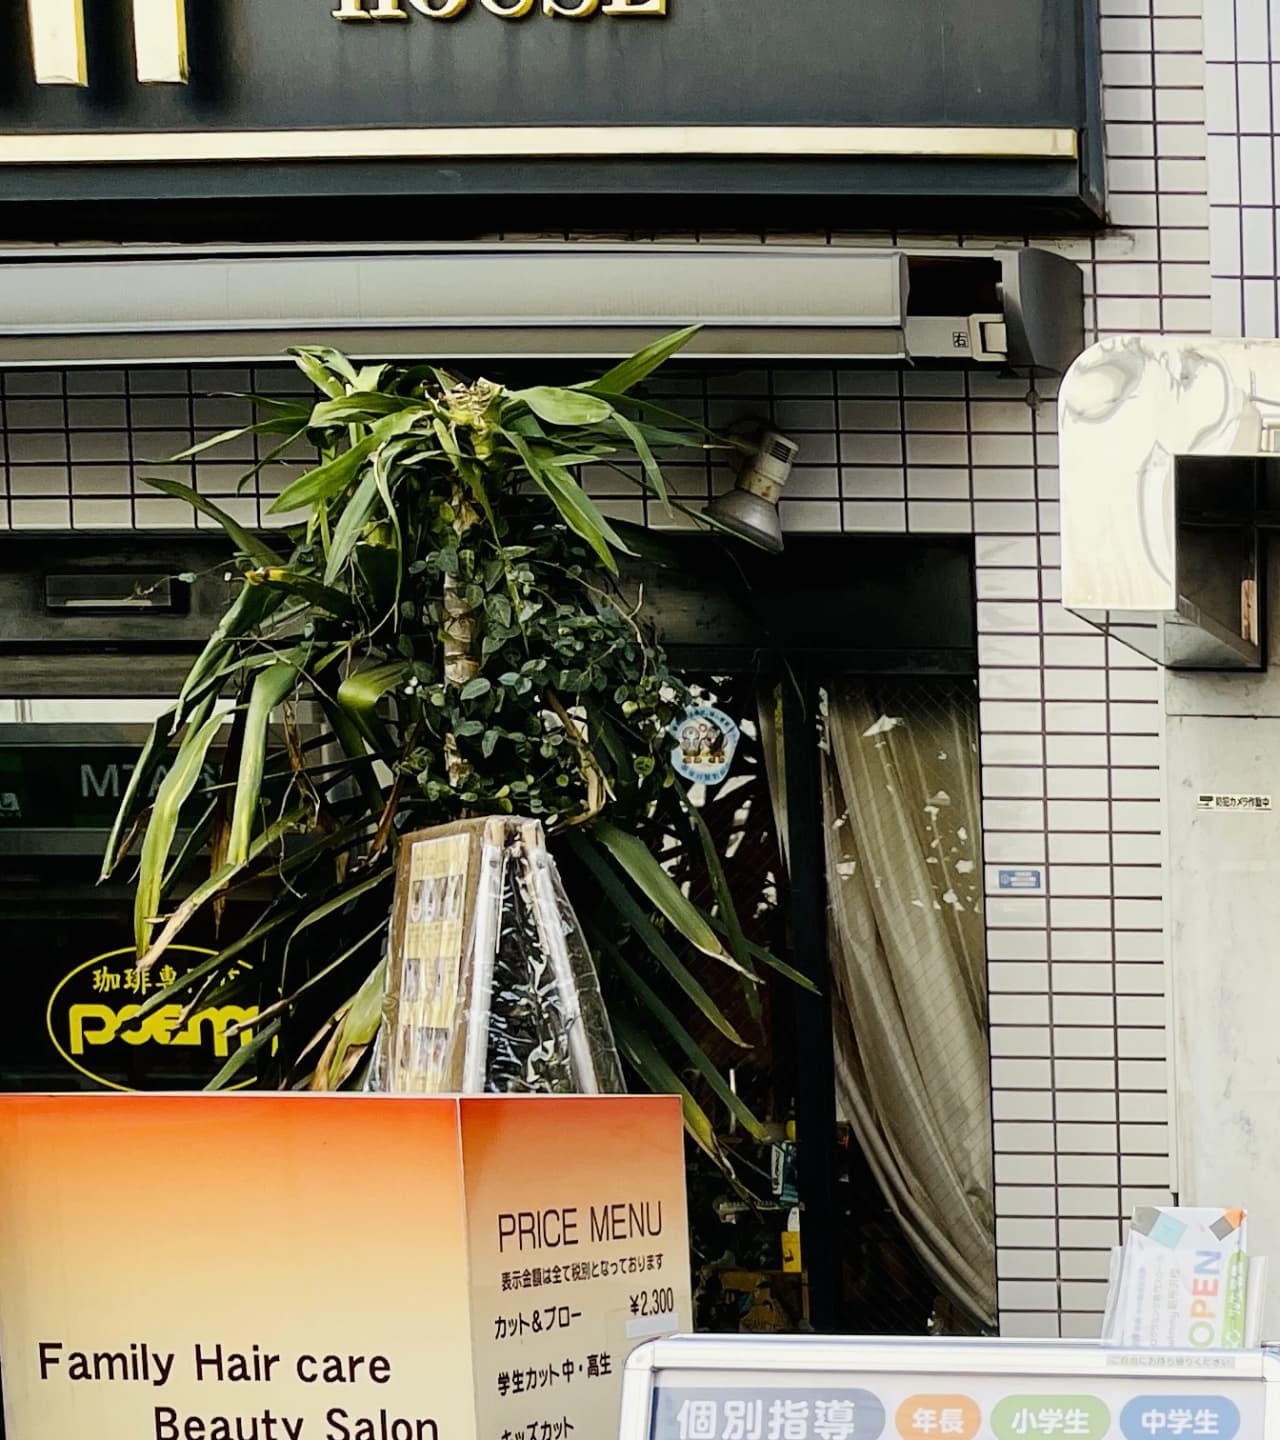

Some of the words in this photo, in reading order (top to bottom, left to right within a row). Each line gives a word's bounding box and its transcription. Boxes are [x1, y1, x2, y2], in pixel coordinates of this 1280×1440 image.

[498, 1208, 578, 1253] PRICE
[590, 1201, 663, 1243] MENU
[501, 1253, 664, 1292] 表示金額は全て税別となっております
[1188, 1250, 1222, 1347] OPEN
[39, 1342, 175, 1386] Family
[194, 1344, 281, 1383] Hair
[296, 1351, 391, 1385] care
[911, 1407, 965, 1434] 年長
[1010, 1408, 1091, 1435] 小学生
[1140, 1408, 1220, 1436] 中学生
